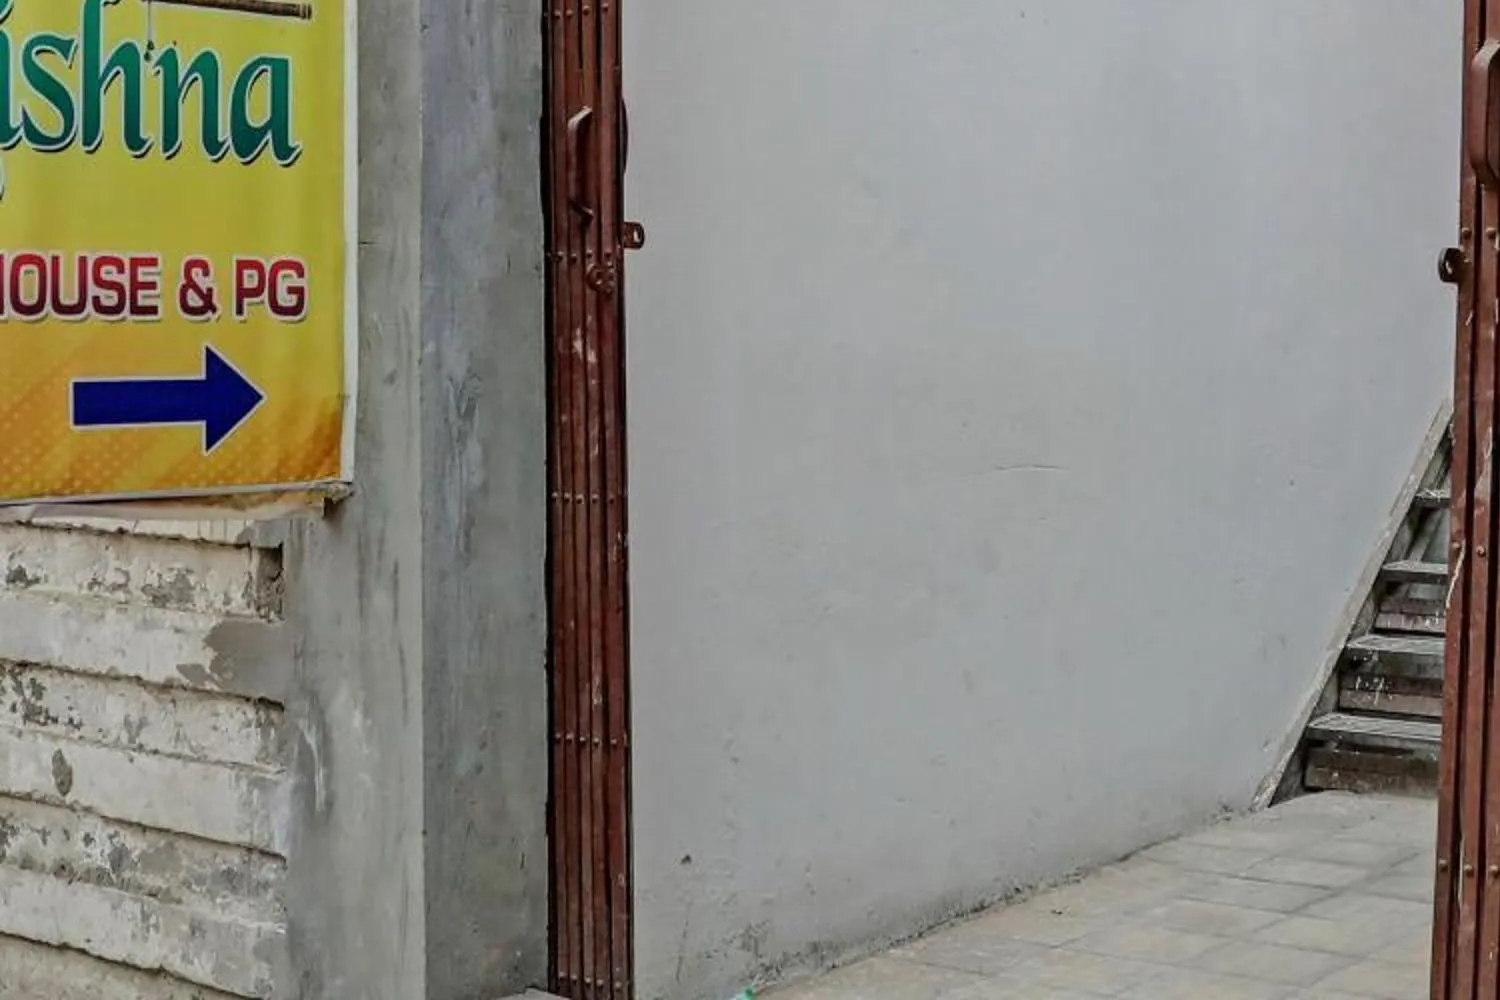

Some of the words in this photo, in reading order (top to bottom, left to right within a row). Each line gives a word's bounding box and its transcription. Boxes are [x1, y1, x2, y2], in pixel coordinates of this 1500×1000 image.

[0, 253, 160, 318] OUSE
[179, 258, 217, 317] &
[234, 258, 307, 319] PG
